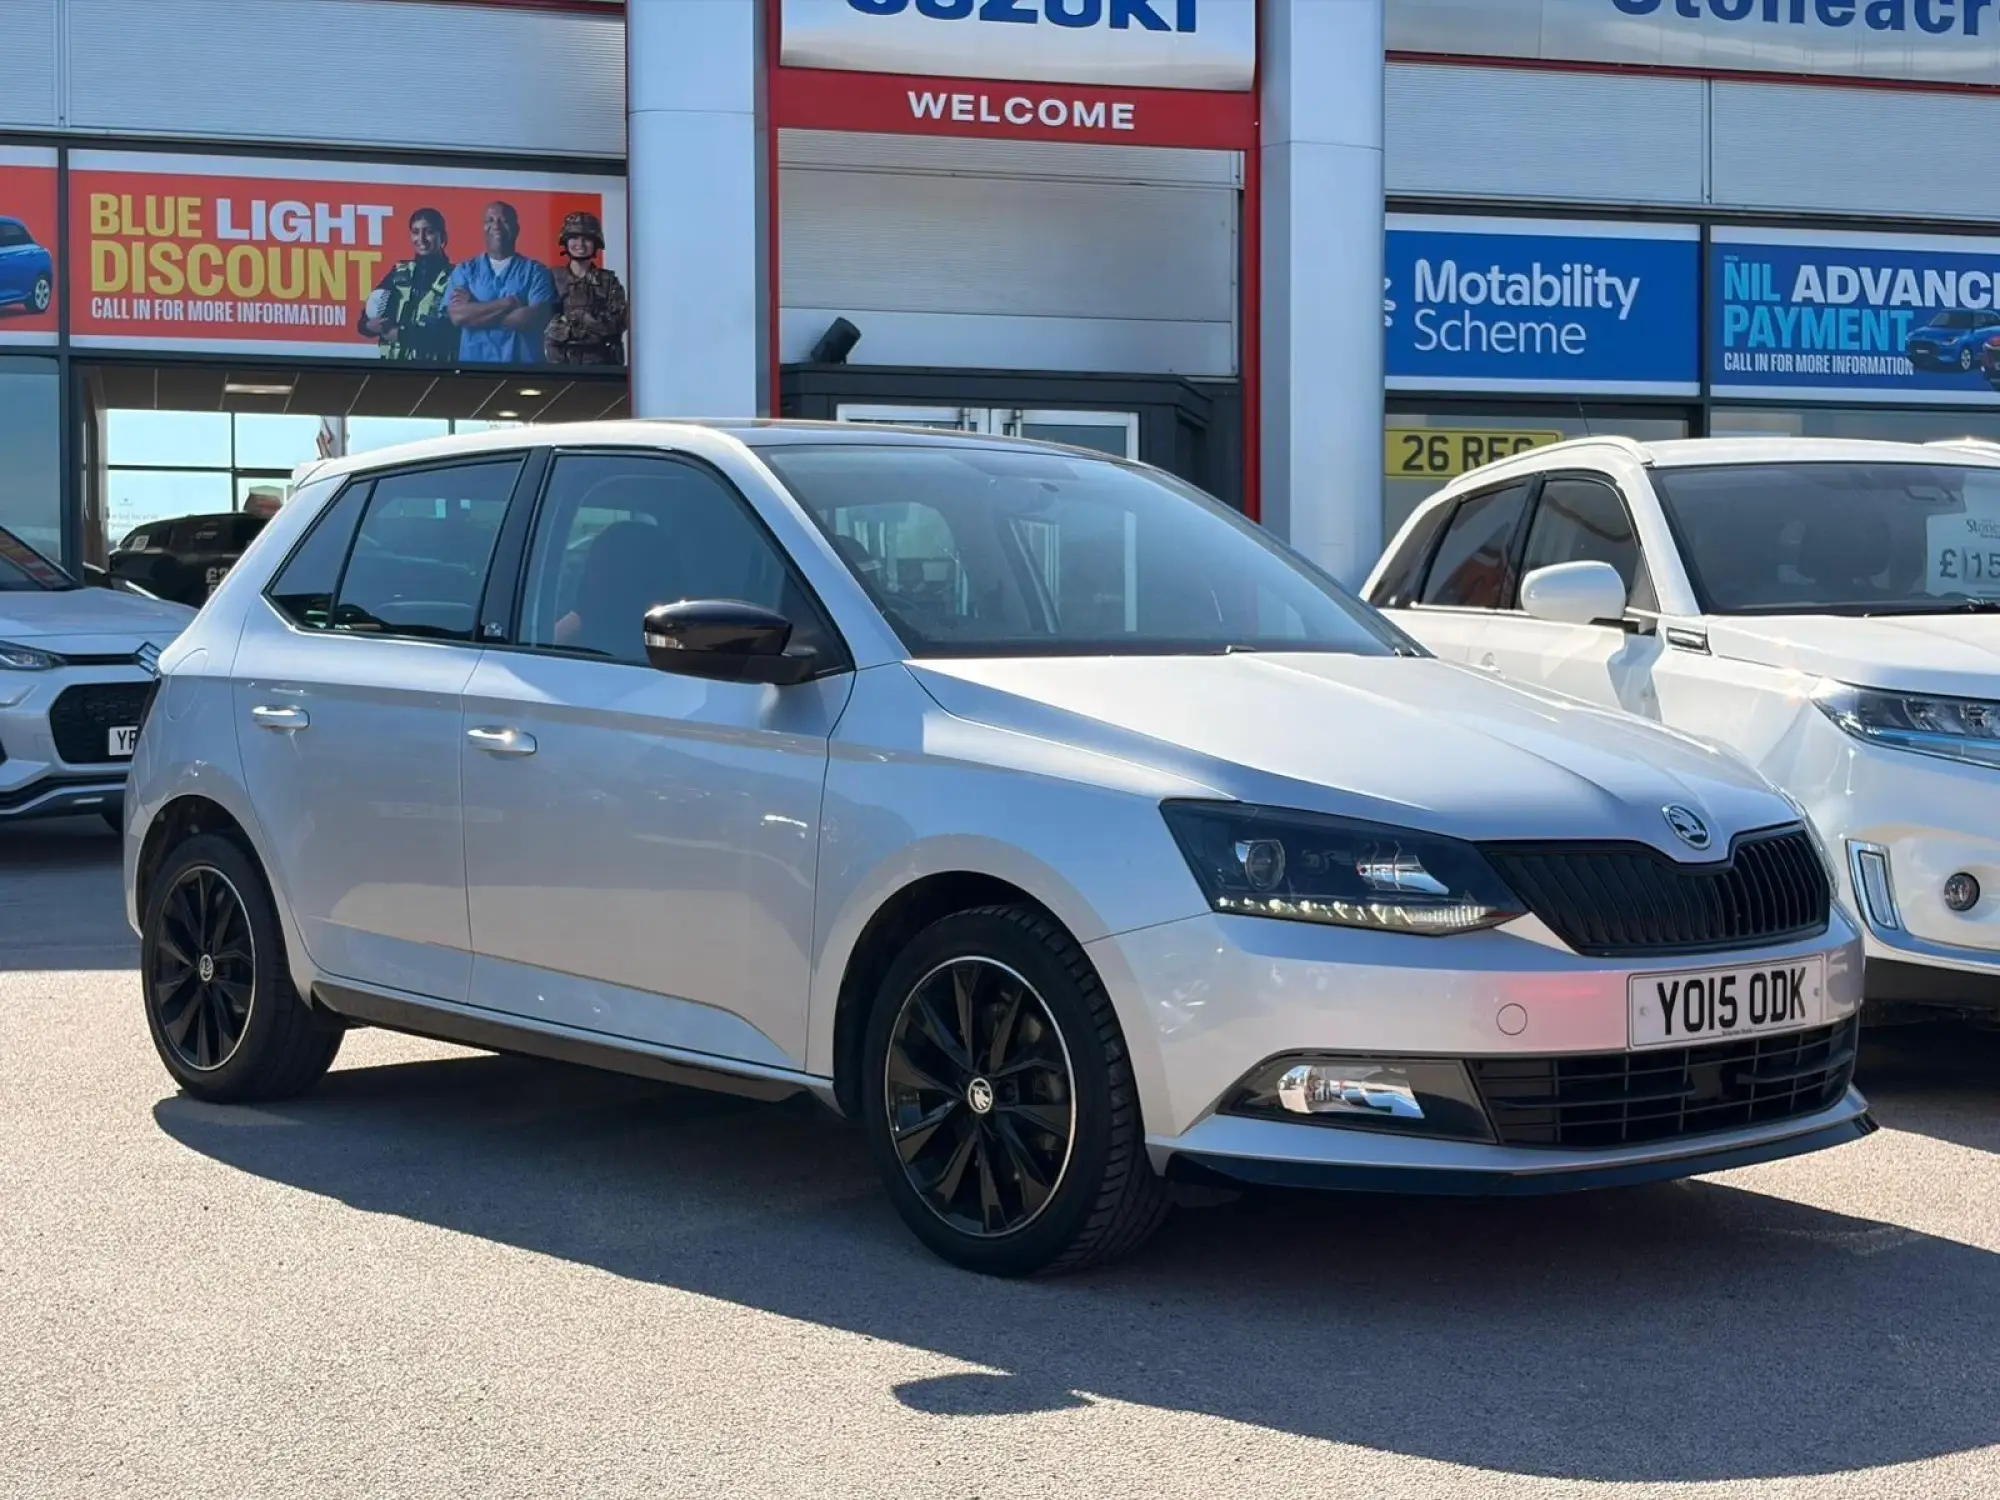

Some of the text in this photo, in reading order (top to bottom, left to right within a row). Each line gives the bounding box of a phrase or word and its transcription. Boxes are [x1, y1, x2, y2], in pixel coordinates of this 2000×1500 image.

[908, 90, 1135, 130] WELCOME
[90, 193, 394, 246] BLUE LIGHT
[91, 239, 382, 302] DISCOUNT
[1414, 258, 1641, 321] Motability
[1723, 262, 2000, 310] NIL ADVANC
[91, 297, 346, 326] CALL IN FOR MORE INFORMATION
[1414, 308, 1587, 355] Scheme
[1723, 304, 1914, 352] PAYMENT
[1724, 352, 1914, 376] CALL IN FOR MORE INFORMATION
[1402, 435, 1449, 472] 26
[1657, 967, 1806, 1035] YO15 ODK
